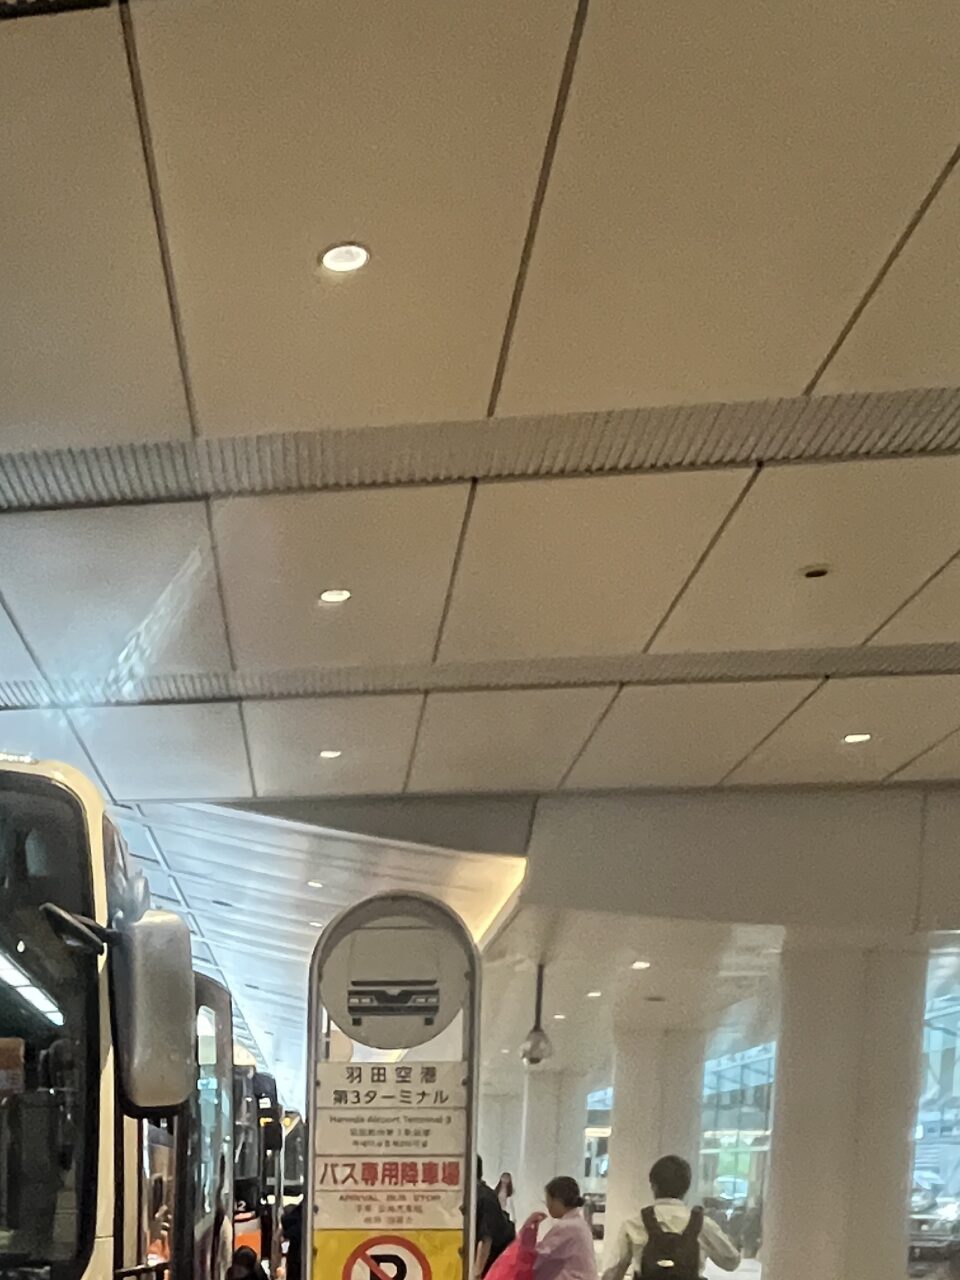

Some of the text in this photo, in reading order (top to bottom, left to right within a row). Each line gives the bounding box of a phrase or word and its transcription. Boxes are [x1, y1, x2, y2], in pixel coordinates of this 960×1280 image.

[346, 1066, 437, 1083] 羽田空港
[333, 1089, 449, 1104] 第3ターミナル
[330, 1115, 365, 1123] Haneda
[367, 1115, 400, 1125] Airport
[403, 1115, 443, 1123] Terminal
[320, 1161, 460, 1186] バス専用降車場
